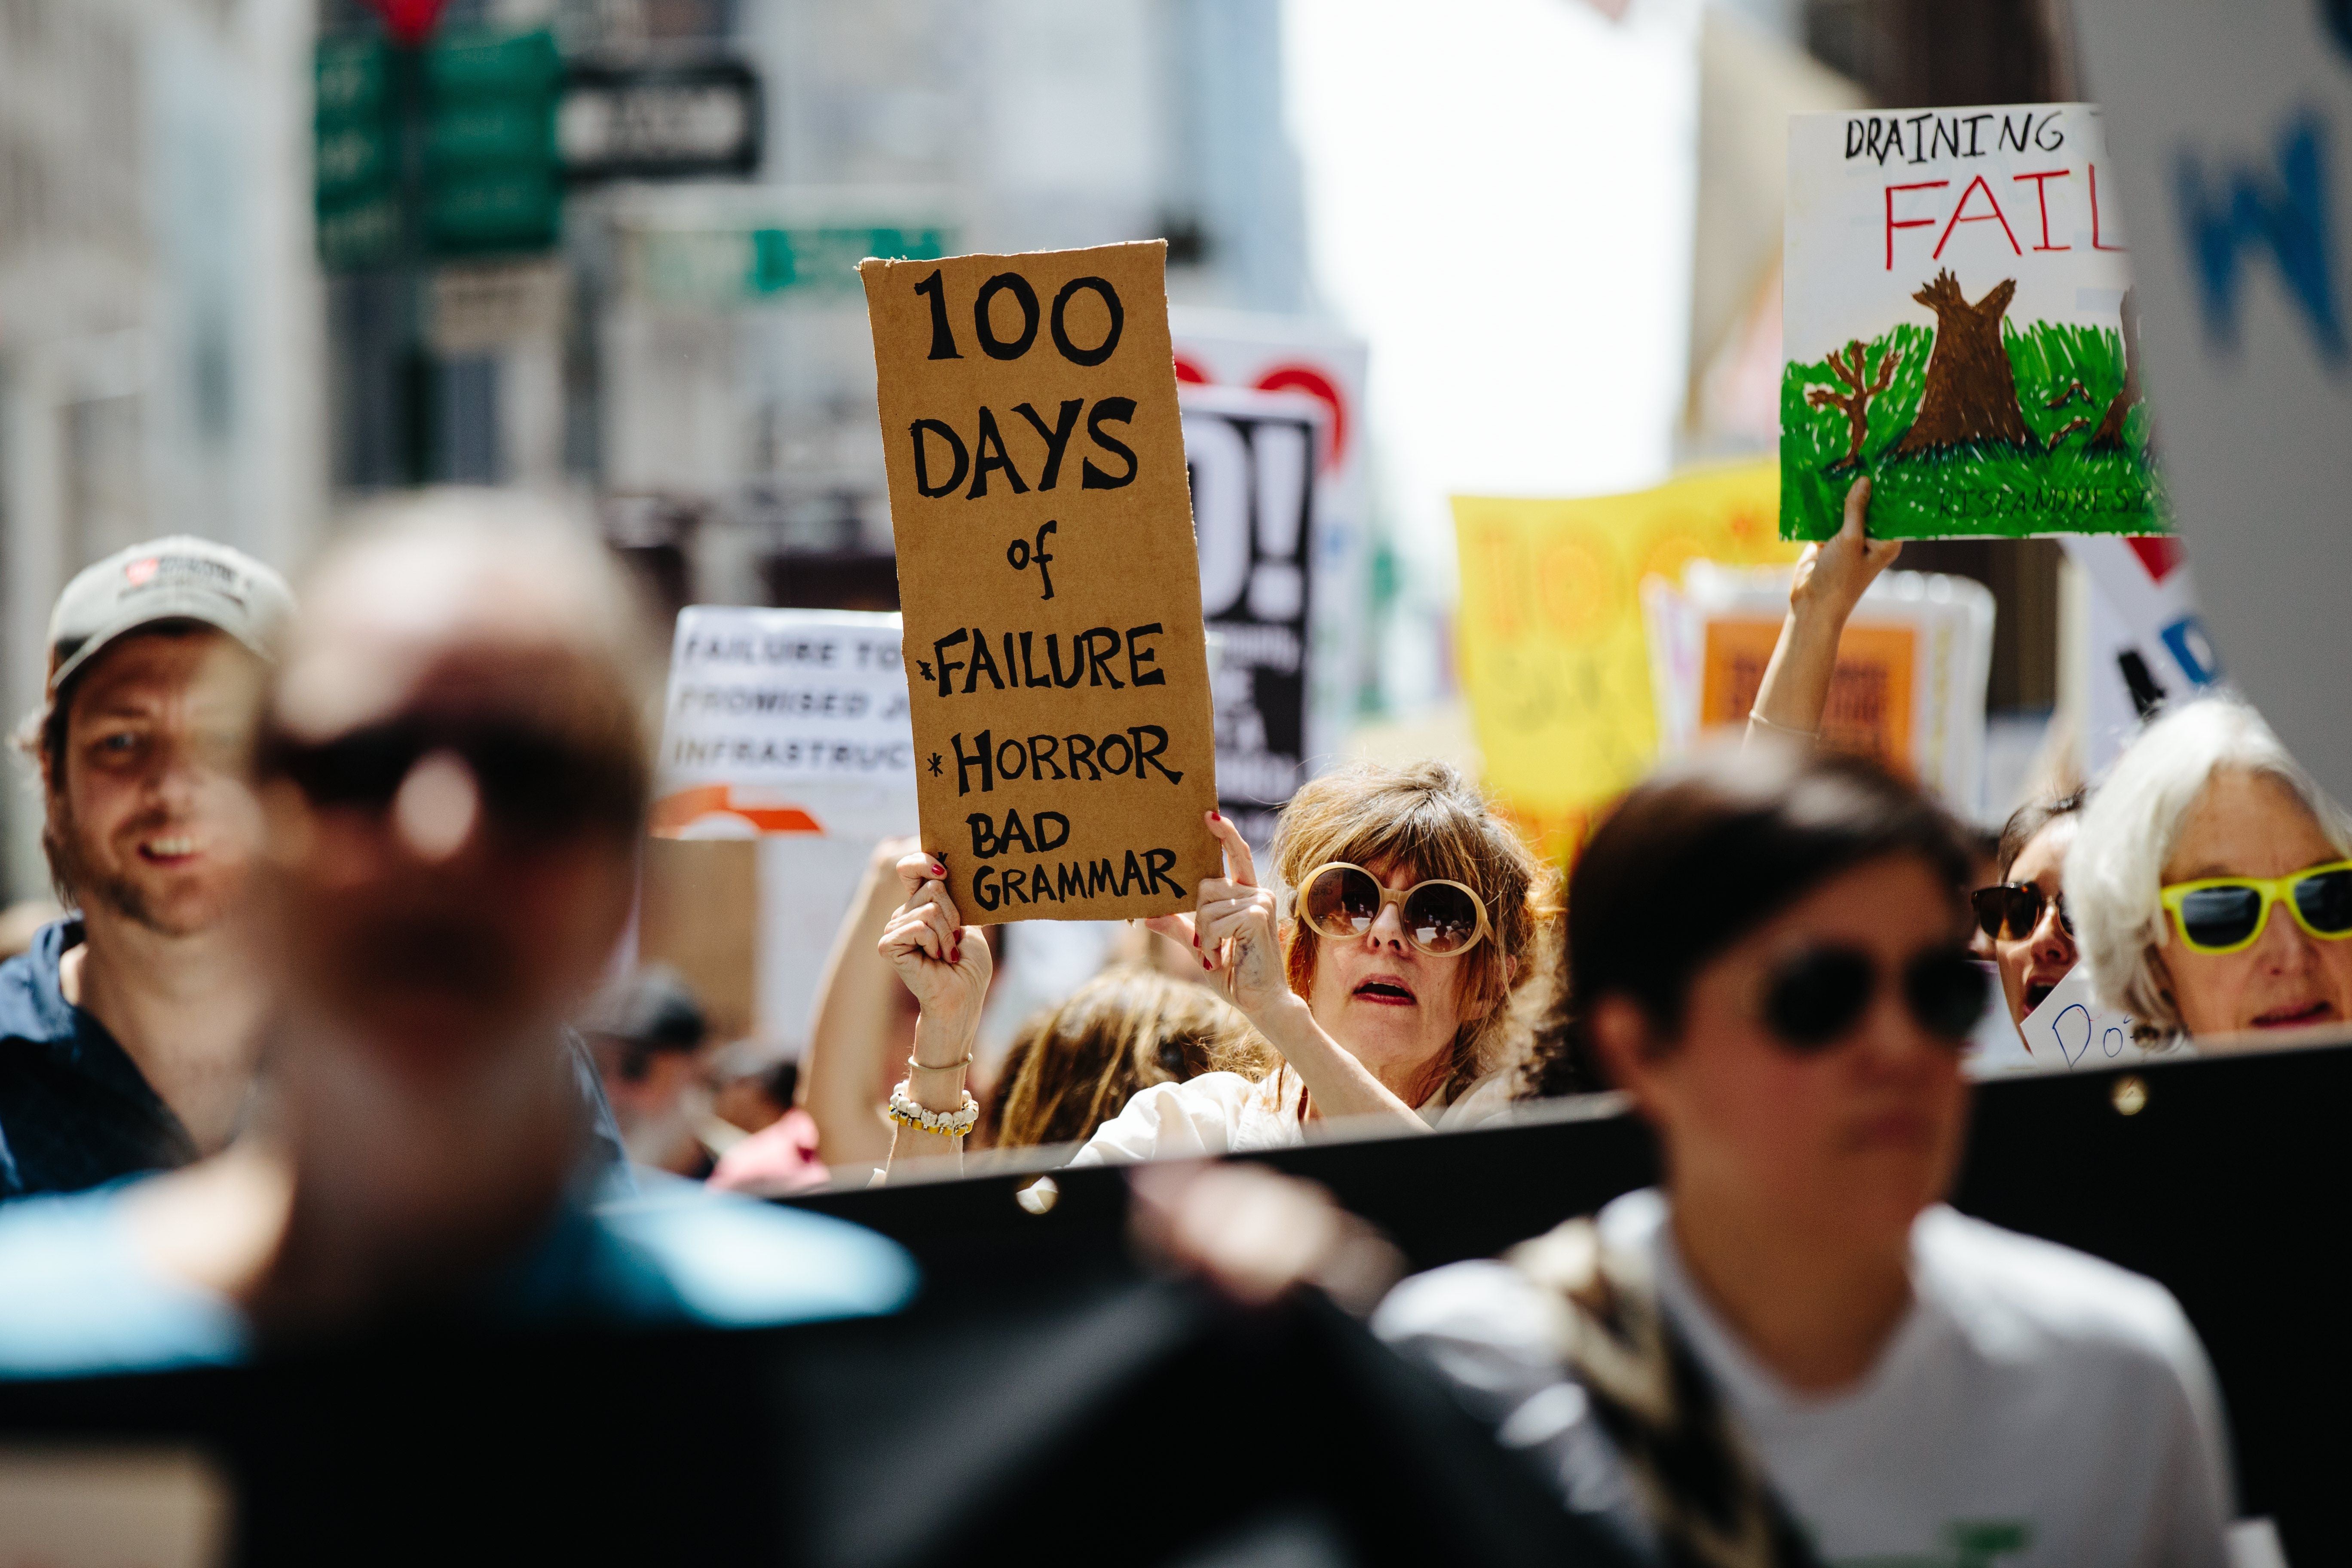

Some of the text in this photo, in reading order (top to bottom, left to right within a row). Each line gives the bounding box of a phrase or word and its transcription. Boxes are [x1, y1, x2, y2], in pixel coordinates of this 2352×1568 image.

[1845, 111, 2064, 165] DRAINING
[914, 269, 1124, 367] 100
[908, 397, 1138, 500] DAYS
[1007, 520, 1057, 600] of
[683, 633, 838, 666] FAILURE
[933, 623, 1166, 697] FAILURE
[951, 725, 1184, 797] HORROR
[966, 808, 1070, 859] BAD
[972, 848, 1187, 911] GRAMMAR
